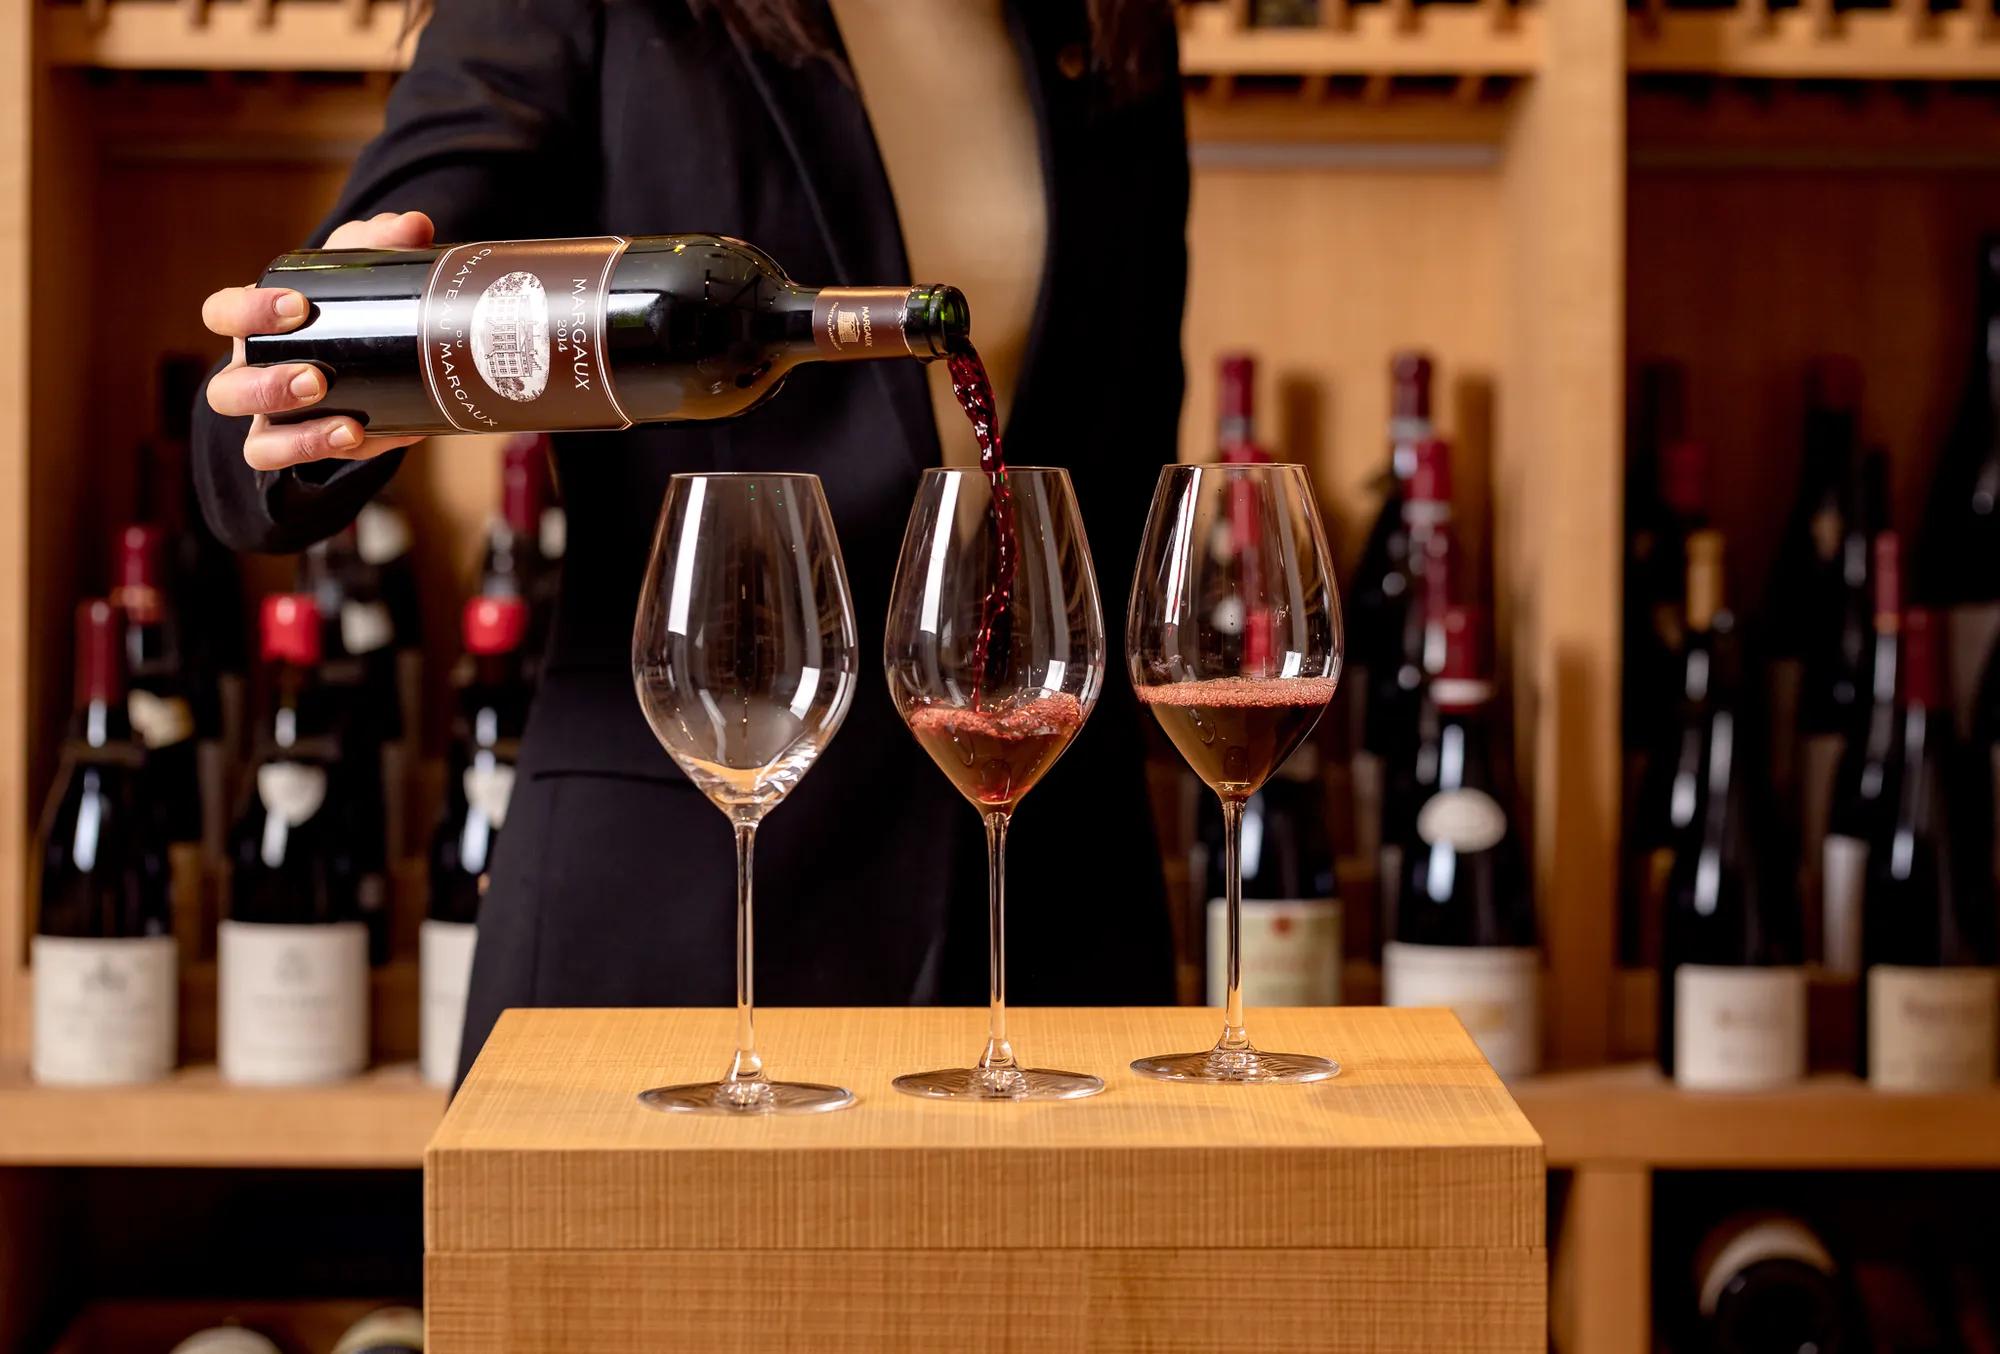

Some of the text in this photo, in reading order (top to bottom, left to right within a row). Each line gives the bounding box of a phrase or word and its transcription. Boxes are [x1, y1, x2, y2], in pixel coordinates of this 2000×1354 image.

[456, 330, 463, 348] DU
[556, 319, 568, 353] 2014
[571, 277, 590, 391] MARGAUX
[861, 305, 873, 347] MARGAUX
[440, 342, 499, 427] MARGAUX
